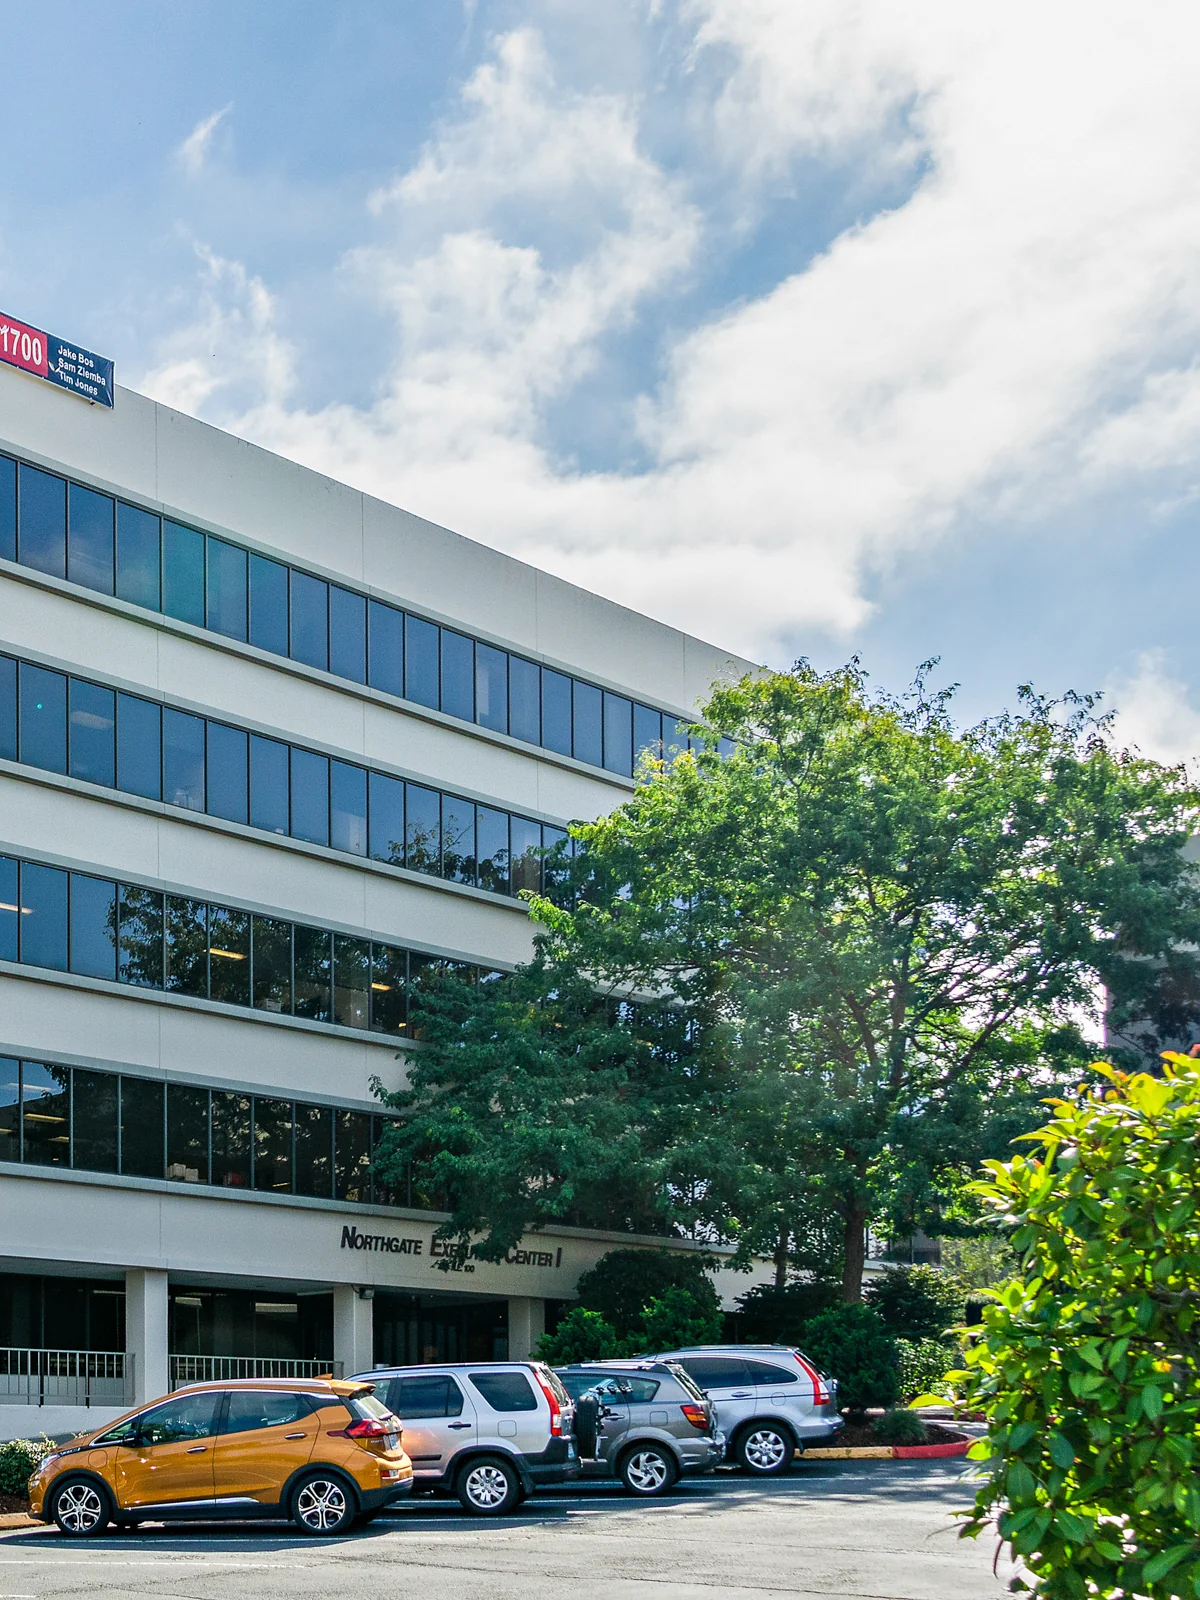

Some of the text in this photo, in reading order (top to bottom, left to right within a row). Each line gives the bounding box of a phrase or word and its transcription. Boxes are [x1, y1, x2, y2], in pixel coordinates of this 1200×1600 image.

[0, 324, 43, 366] 1700
[57, 344, 95, 368] Jake Bos
[58, 357, 107, 387] Sam Ziemba
[59, 370, 99, 396] Tim Jones
